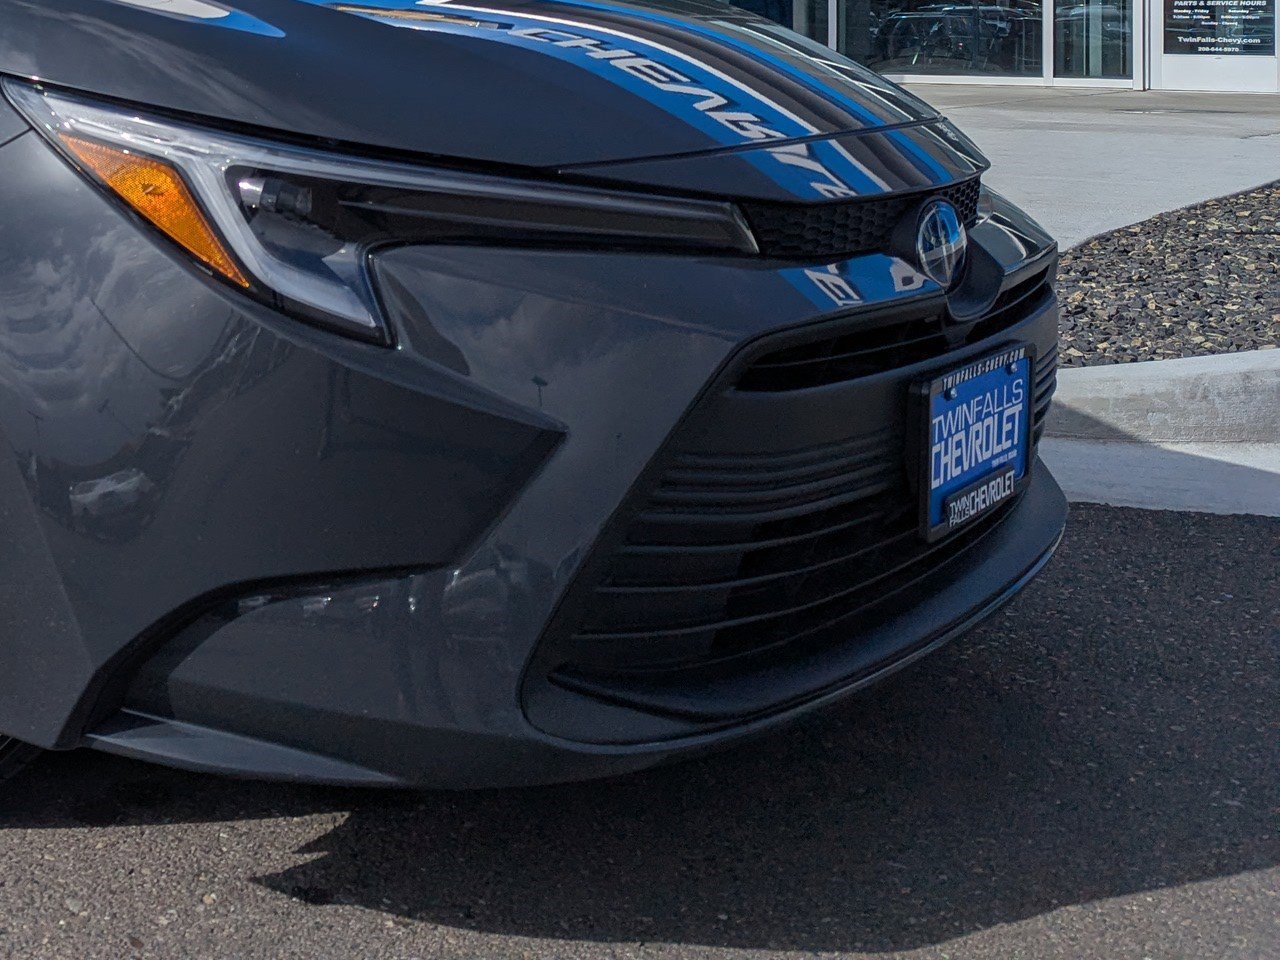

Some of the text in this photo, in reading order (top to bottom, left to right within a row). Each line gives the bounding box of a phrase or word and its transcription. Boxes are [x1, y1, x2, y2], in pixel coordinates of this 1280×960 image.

[932, 378, 1023, 443] TWINFALLS
[931, 403, 1023, 490] CHEVROLET
[949, 494, 970, 517] TWIN
[969, 470, 1015, 516] CHEVROLET
[949, 507, 970, 527] FALLS
